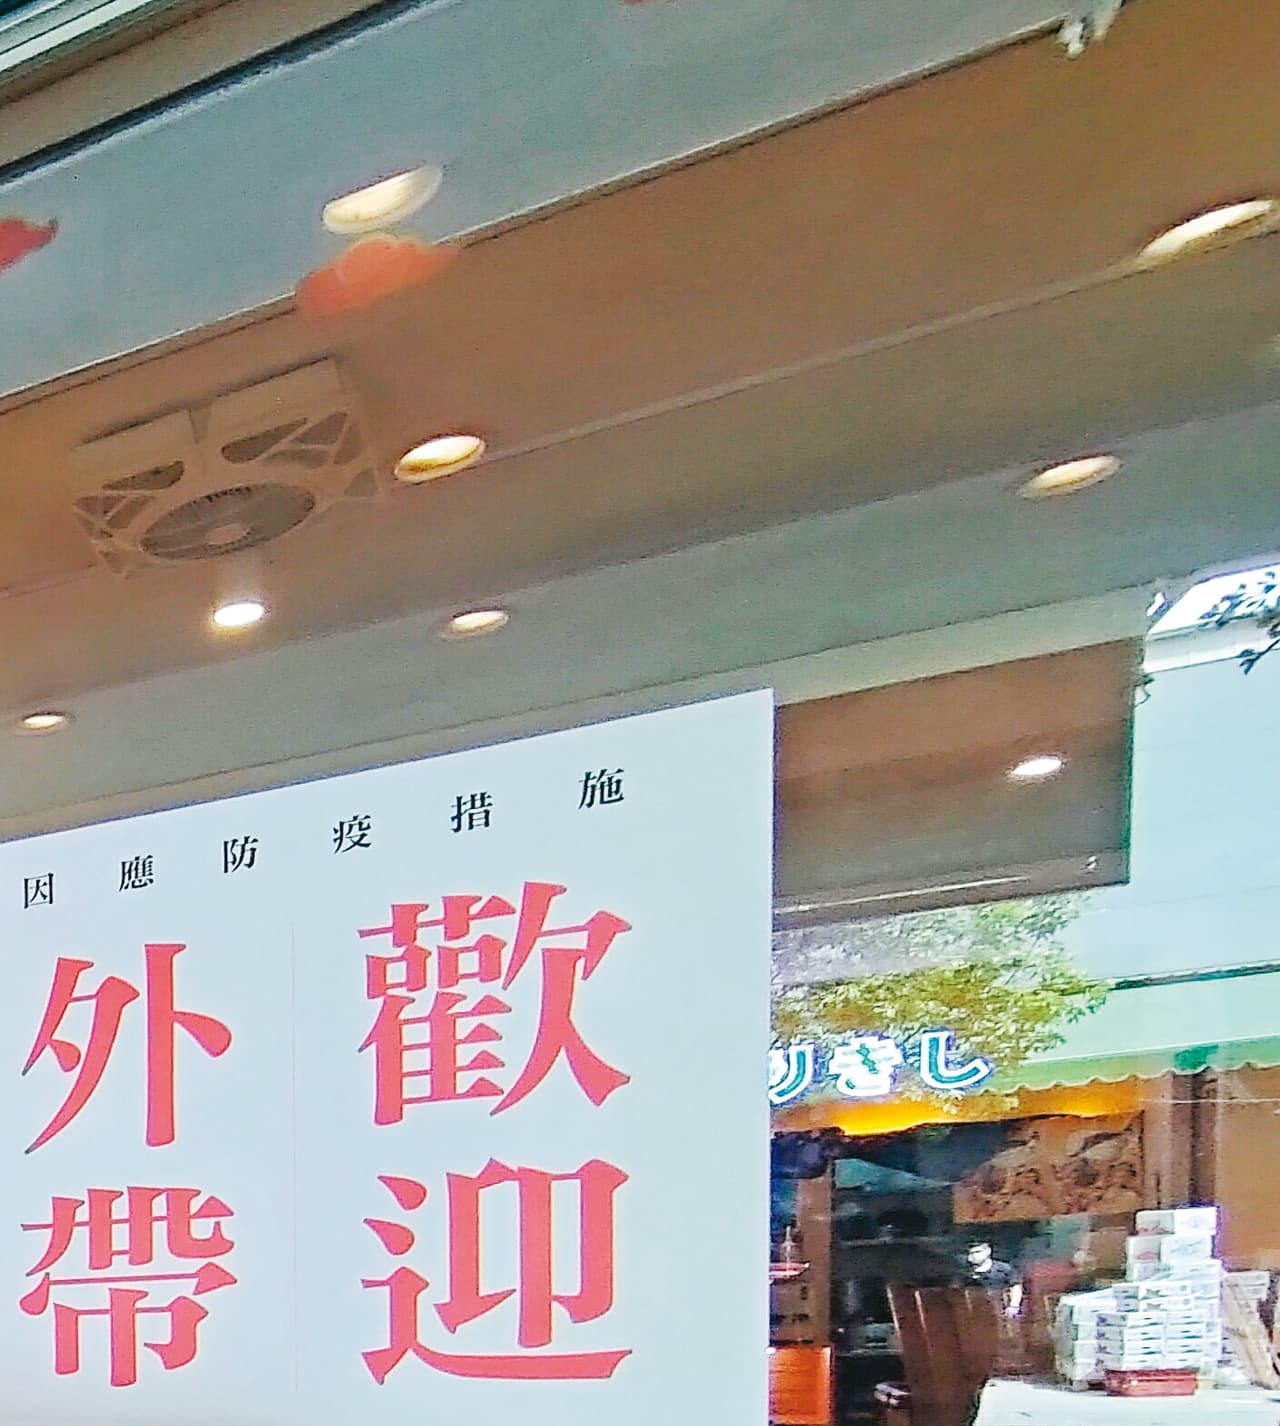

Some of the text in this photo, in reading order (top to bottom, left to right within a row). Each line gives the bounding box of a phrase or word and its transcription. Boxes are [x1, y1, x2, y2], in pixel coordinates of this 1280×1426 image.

[22, 766, 625, 909] 因應防疫措施
[18, 942, 238, 1388] 外帶
[358, 880, 633, 1387] 歡迎
